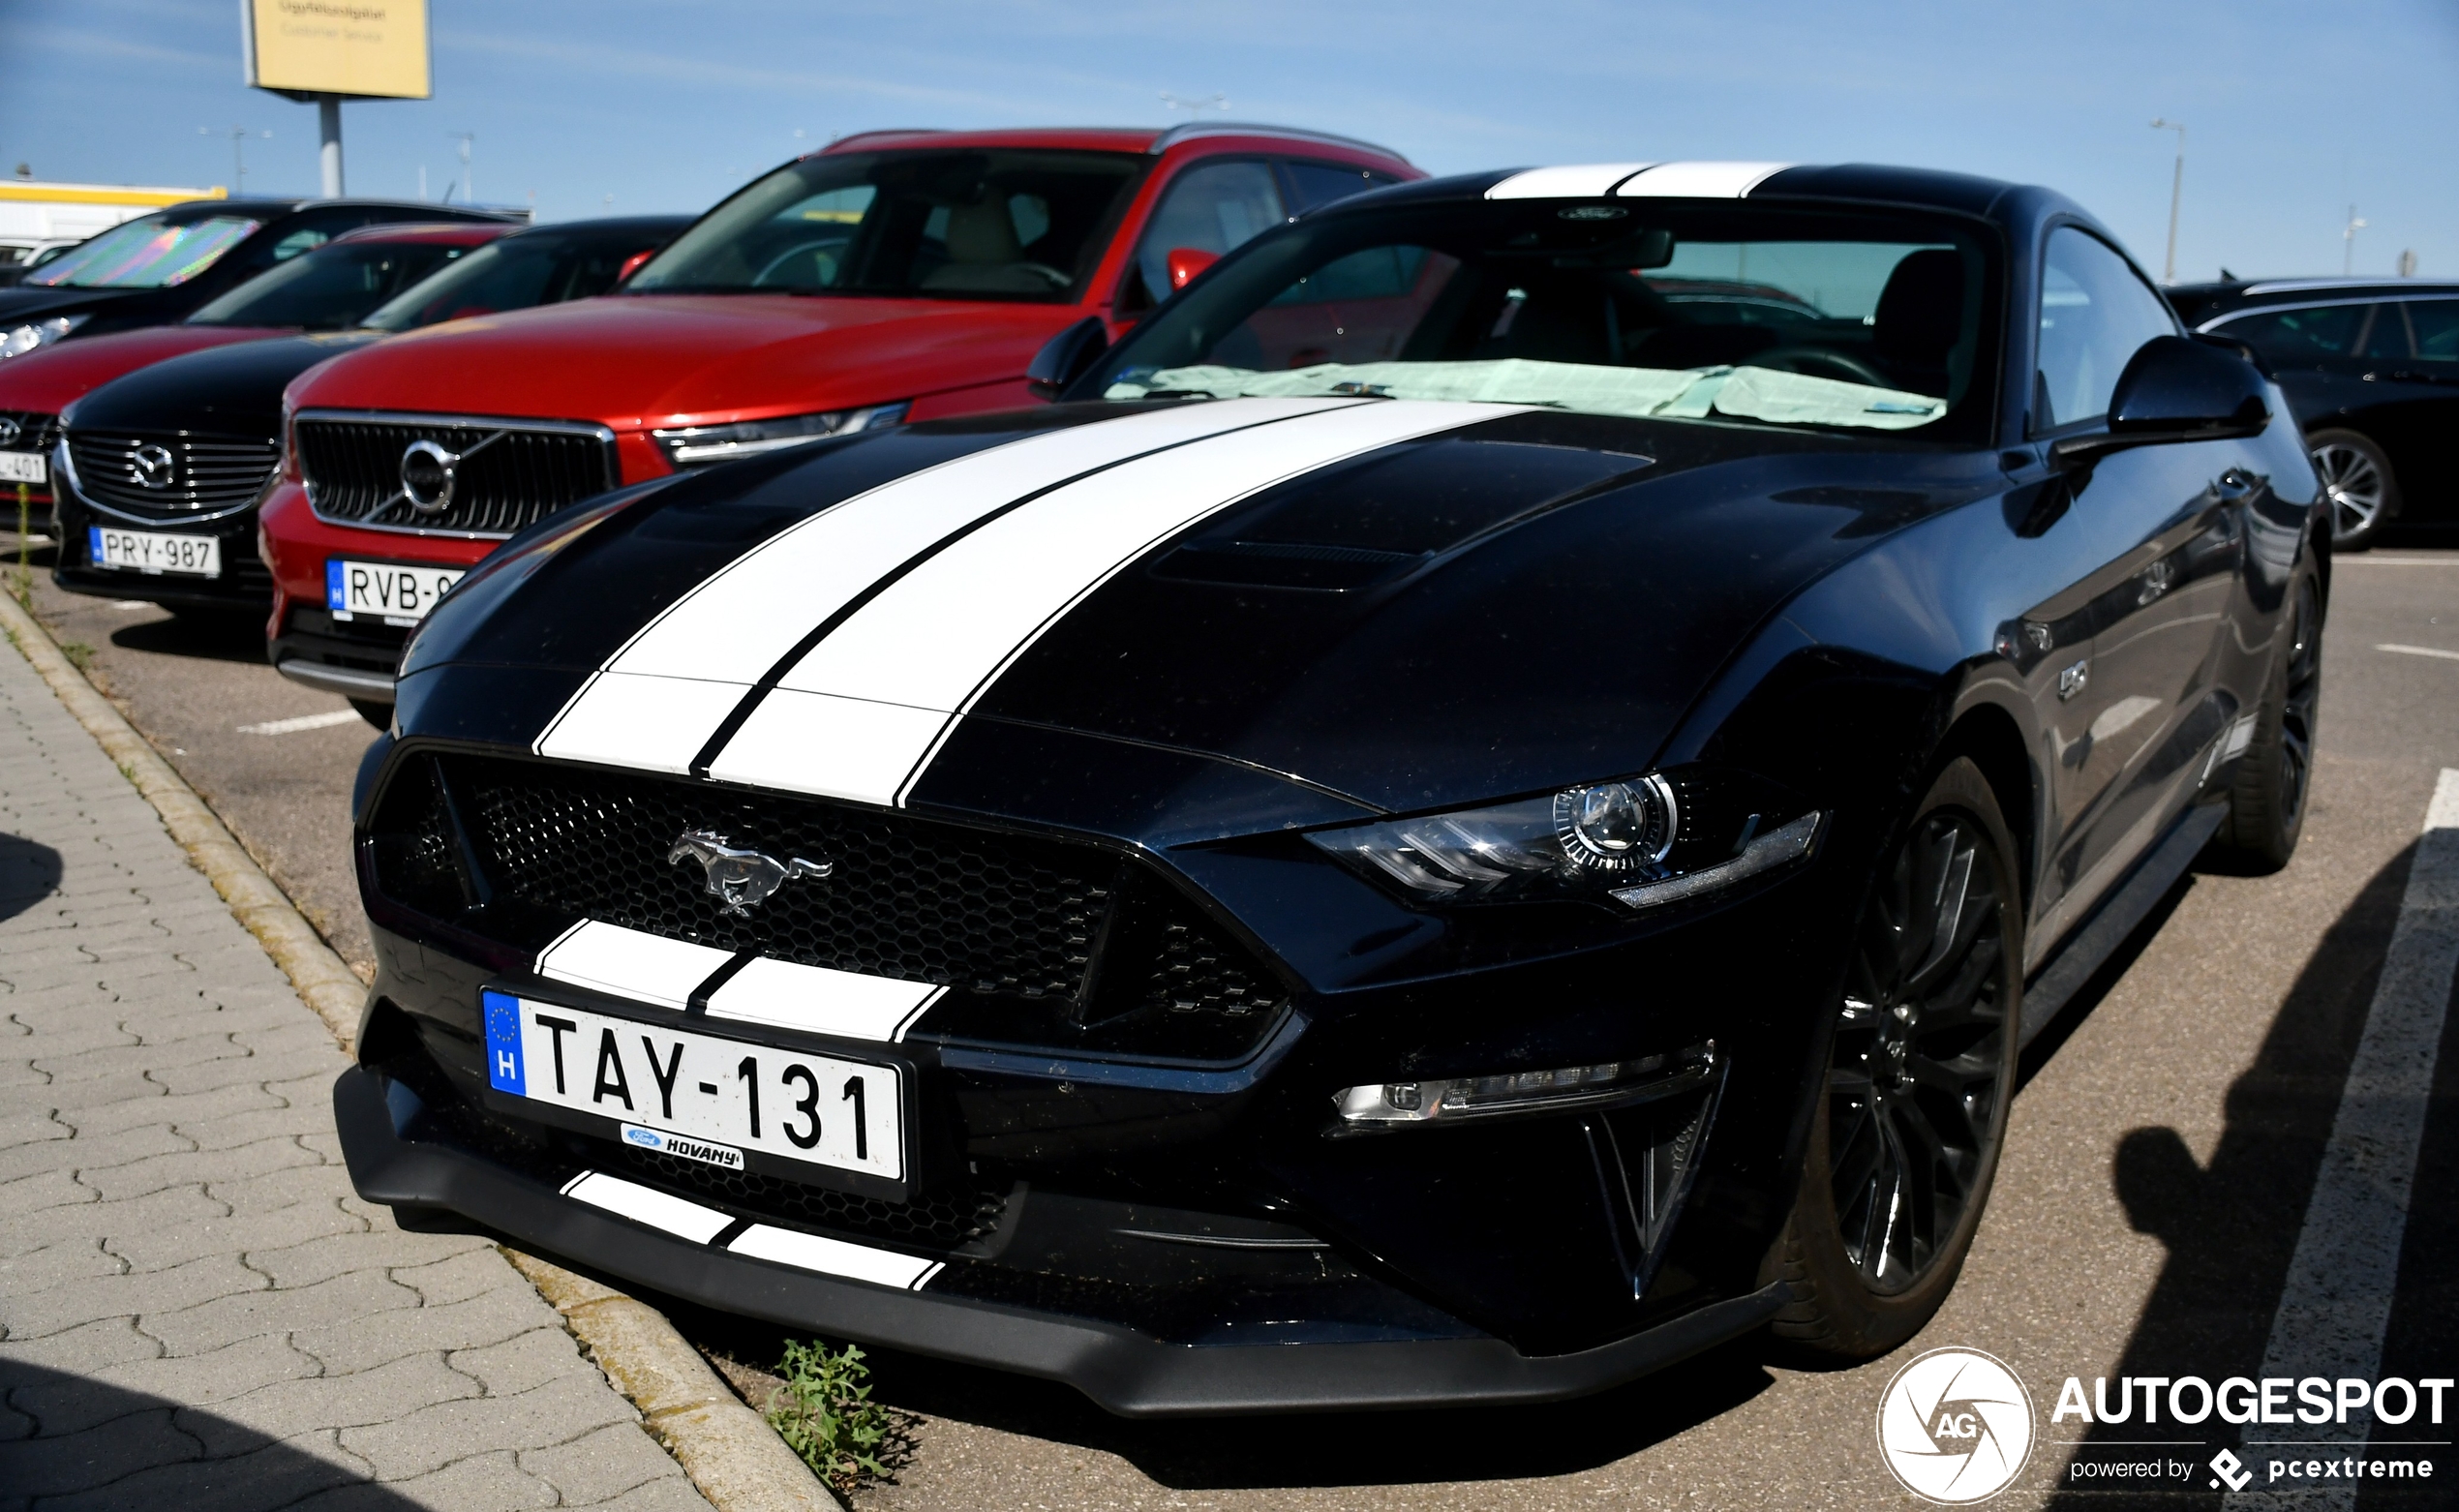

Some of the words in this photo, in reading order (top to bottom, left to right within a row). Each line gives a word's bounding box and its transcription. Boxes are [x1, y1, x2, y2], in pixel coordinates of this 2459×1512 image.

[106, 533, 209, 567] PRY-987
[497, 1048, 516, 1080] H
[535, 1013, 868, 1161] TAY-131
[631, 1130, 657, 1145] Ford
